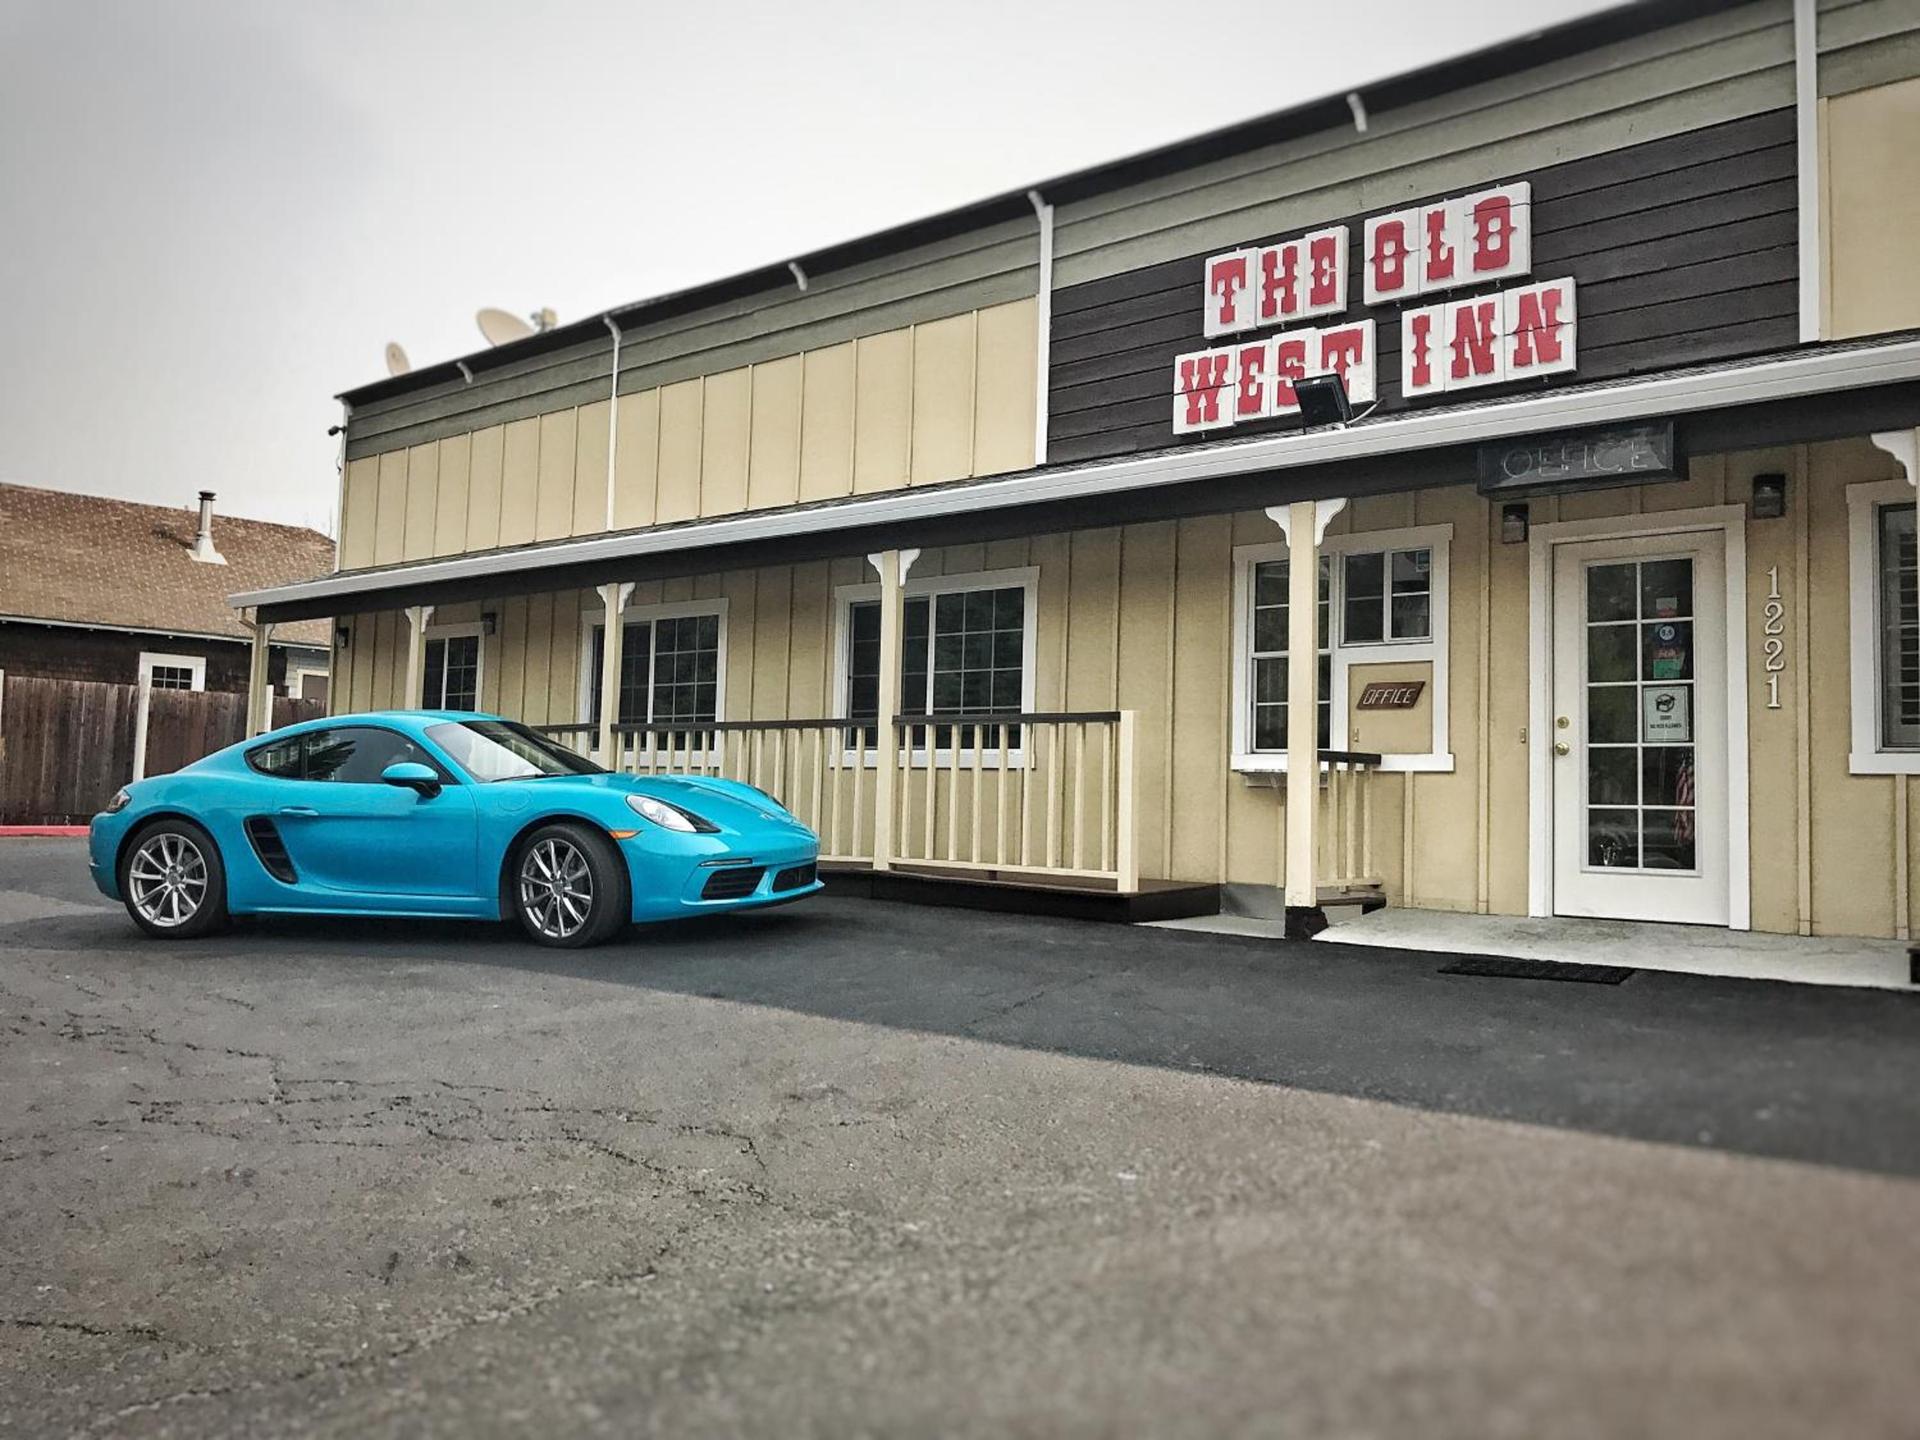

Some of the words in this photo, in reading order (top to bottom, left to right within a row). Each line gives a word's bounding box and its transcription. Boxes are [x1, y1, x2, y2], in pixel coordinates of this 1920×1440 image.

[1211, 235, 1337, 325] THE
[1369, 194, 1517, 293] OLD
[1180, 327, 1364, 426] WEST
[1412, 287, 1563, 388] INN
[1362, 687, 1417, 705] OFFICE
[1764, 564, 1785, 709] 1221
